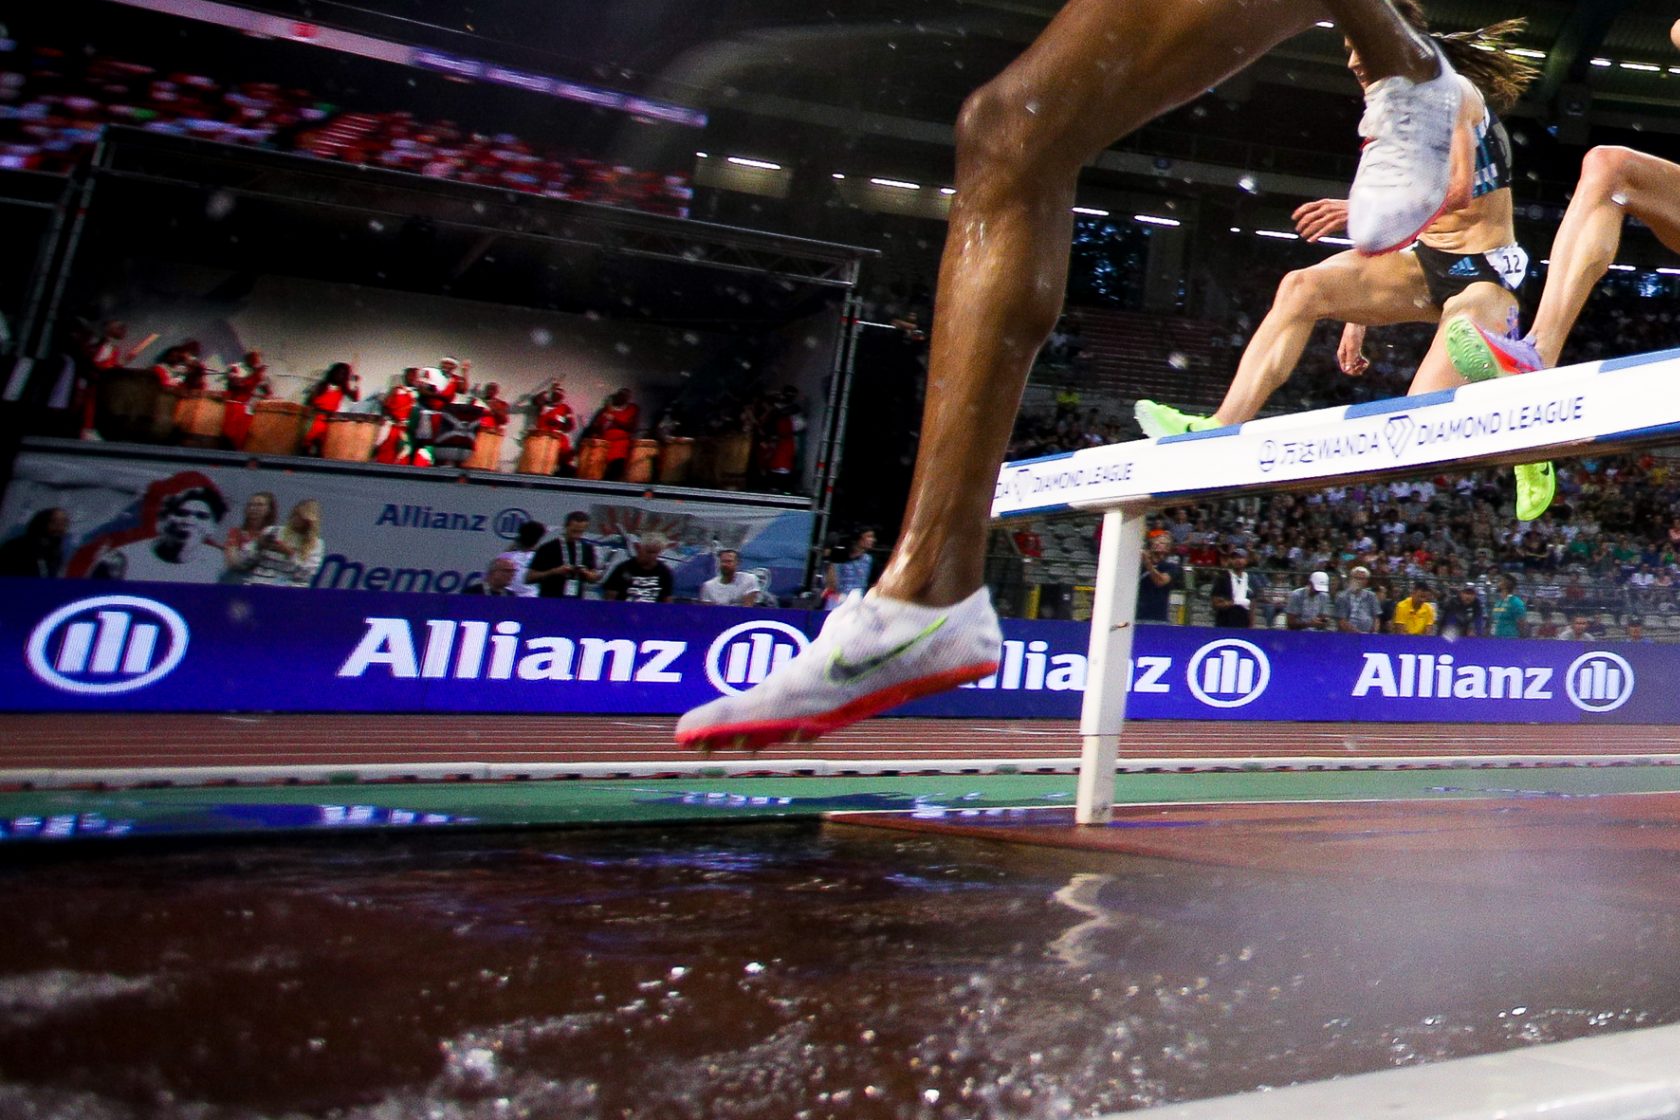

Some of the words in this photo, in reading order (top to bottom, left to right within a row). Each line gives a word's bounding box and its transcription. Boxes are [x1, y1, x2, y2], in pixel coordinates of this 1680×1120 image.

[1503, 254, 1522, 274] 12
[1417, 411, 1501, 447] DIAMOND
[1508, 396, 1585, 432] LEAGUE
[375, 503, 489, 532] Allianz
[336, 617, 687, 683] Allianz
[1351, 652, 1553, 700] Allianz
